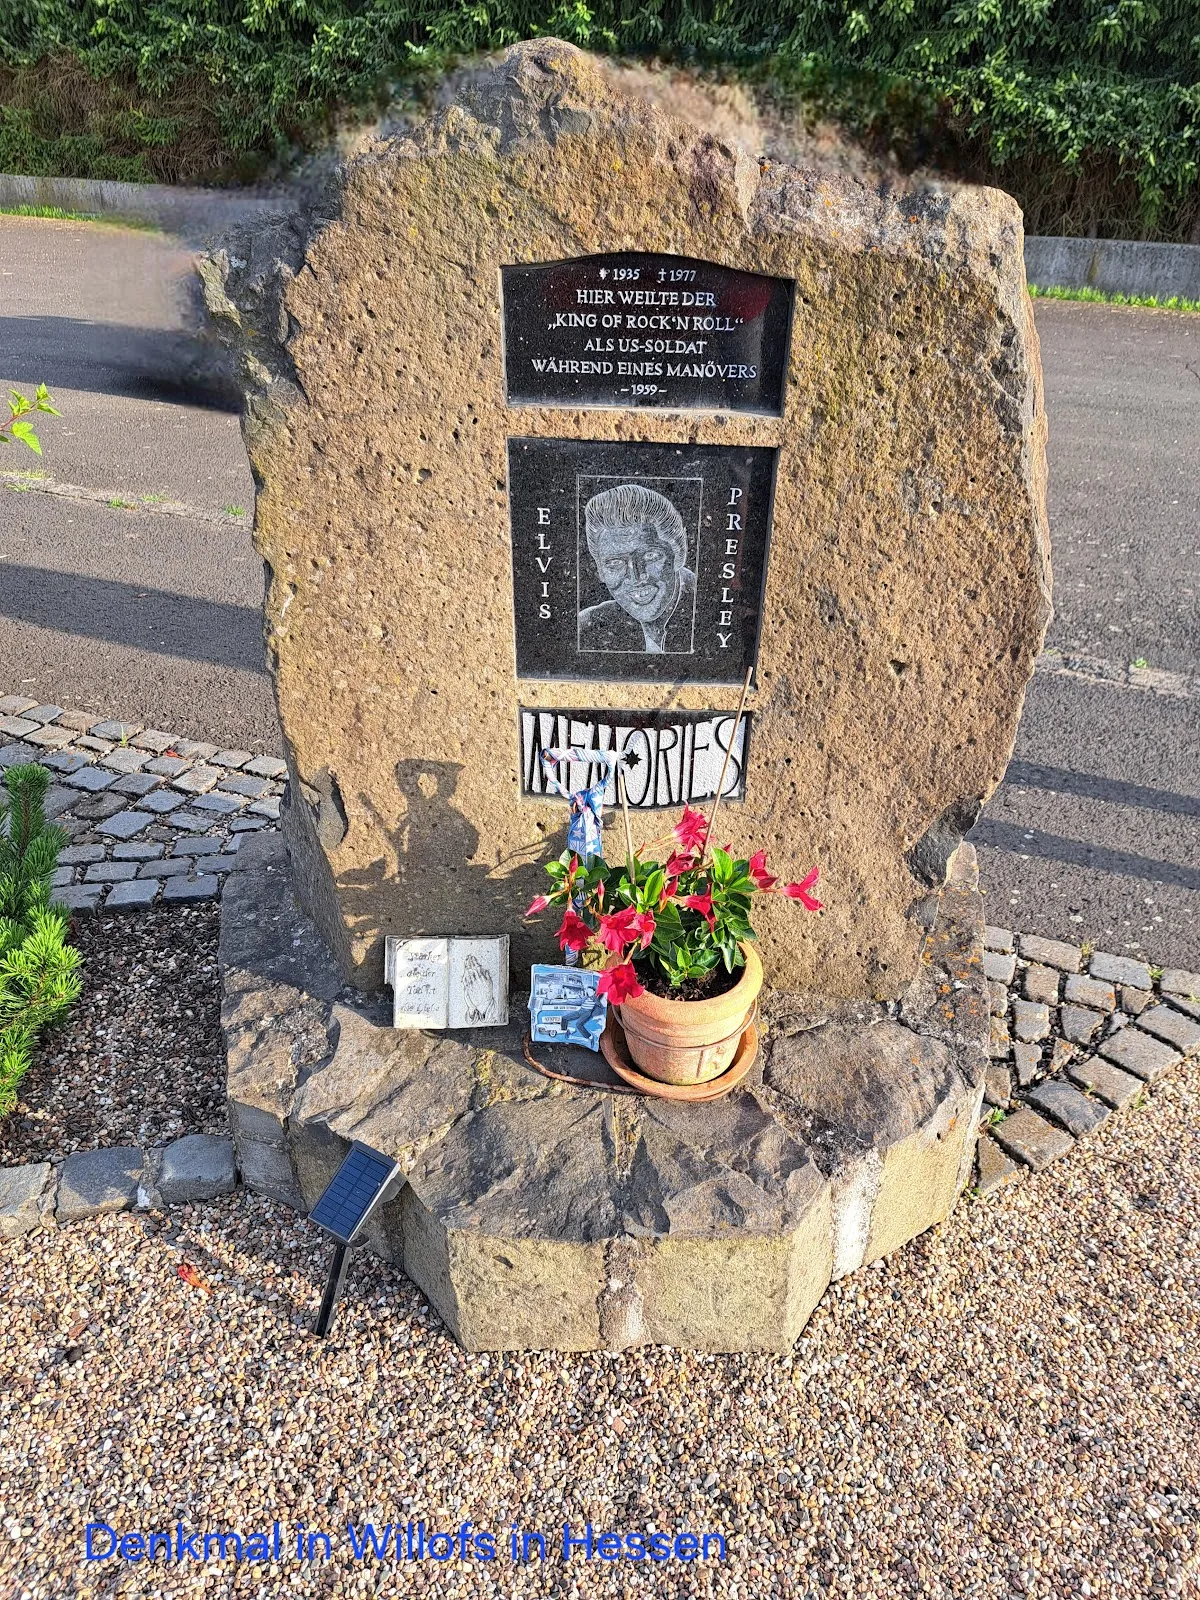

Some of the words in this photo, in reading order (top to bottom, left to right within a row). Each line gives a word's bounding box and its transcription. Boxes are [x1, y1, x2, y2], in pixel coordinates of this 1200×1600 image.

[612, 268, 640, 281] 1935
[669, 269, 697, 282] 1977
[576, 289, 615, 305] HIER
[618, 290, 679, 306] WEILTE
[681, 291, 717, 307] DER
[601, 314, 622, 329] OF
[584, 338, 615, 352] ALS
[618, 339, 708, 354] US-SOLDAT
[531, 357, 614, 375] WÄHREND
[617, 361, 663, 377] EINES
[667, 360, 758, 379] MANÖVERS
[535, 507, 552, 619] ELVIS
[716, 487, 744, 648] PRESLEY
